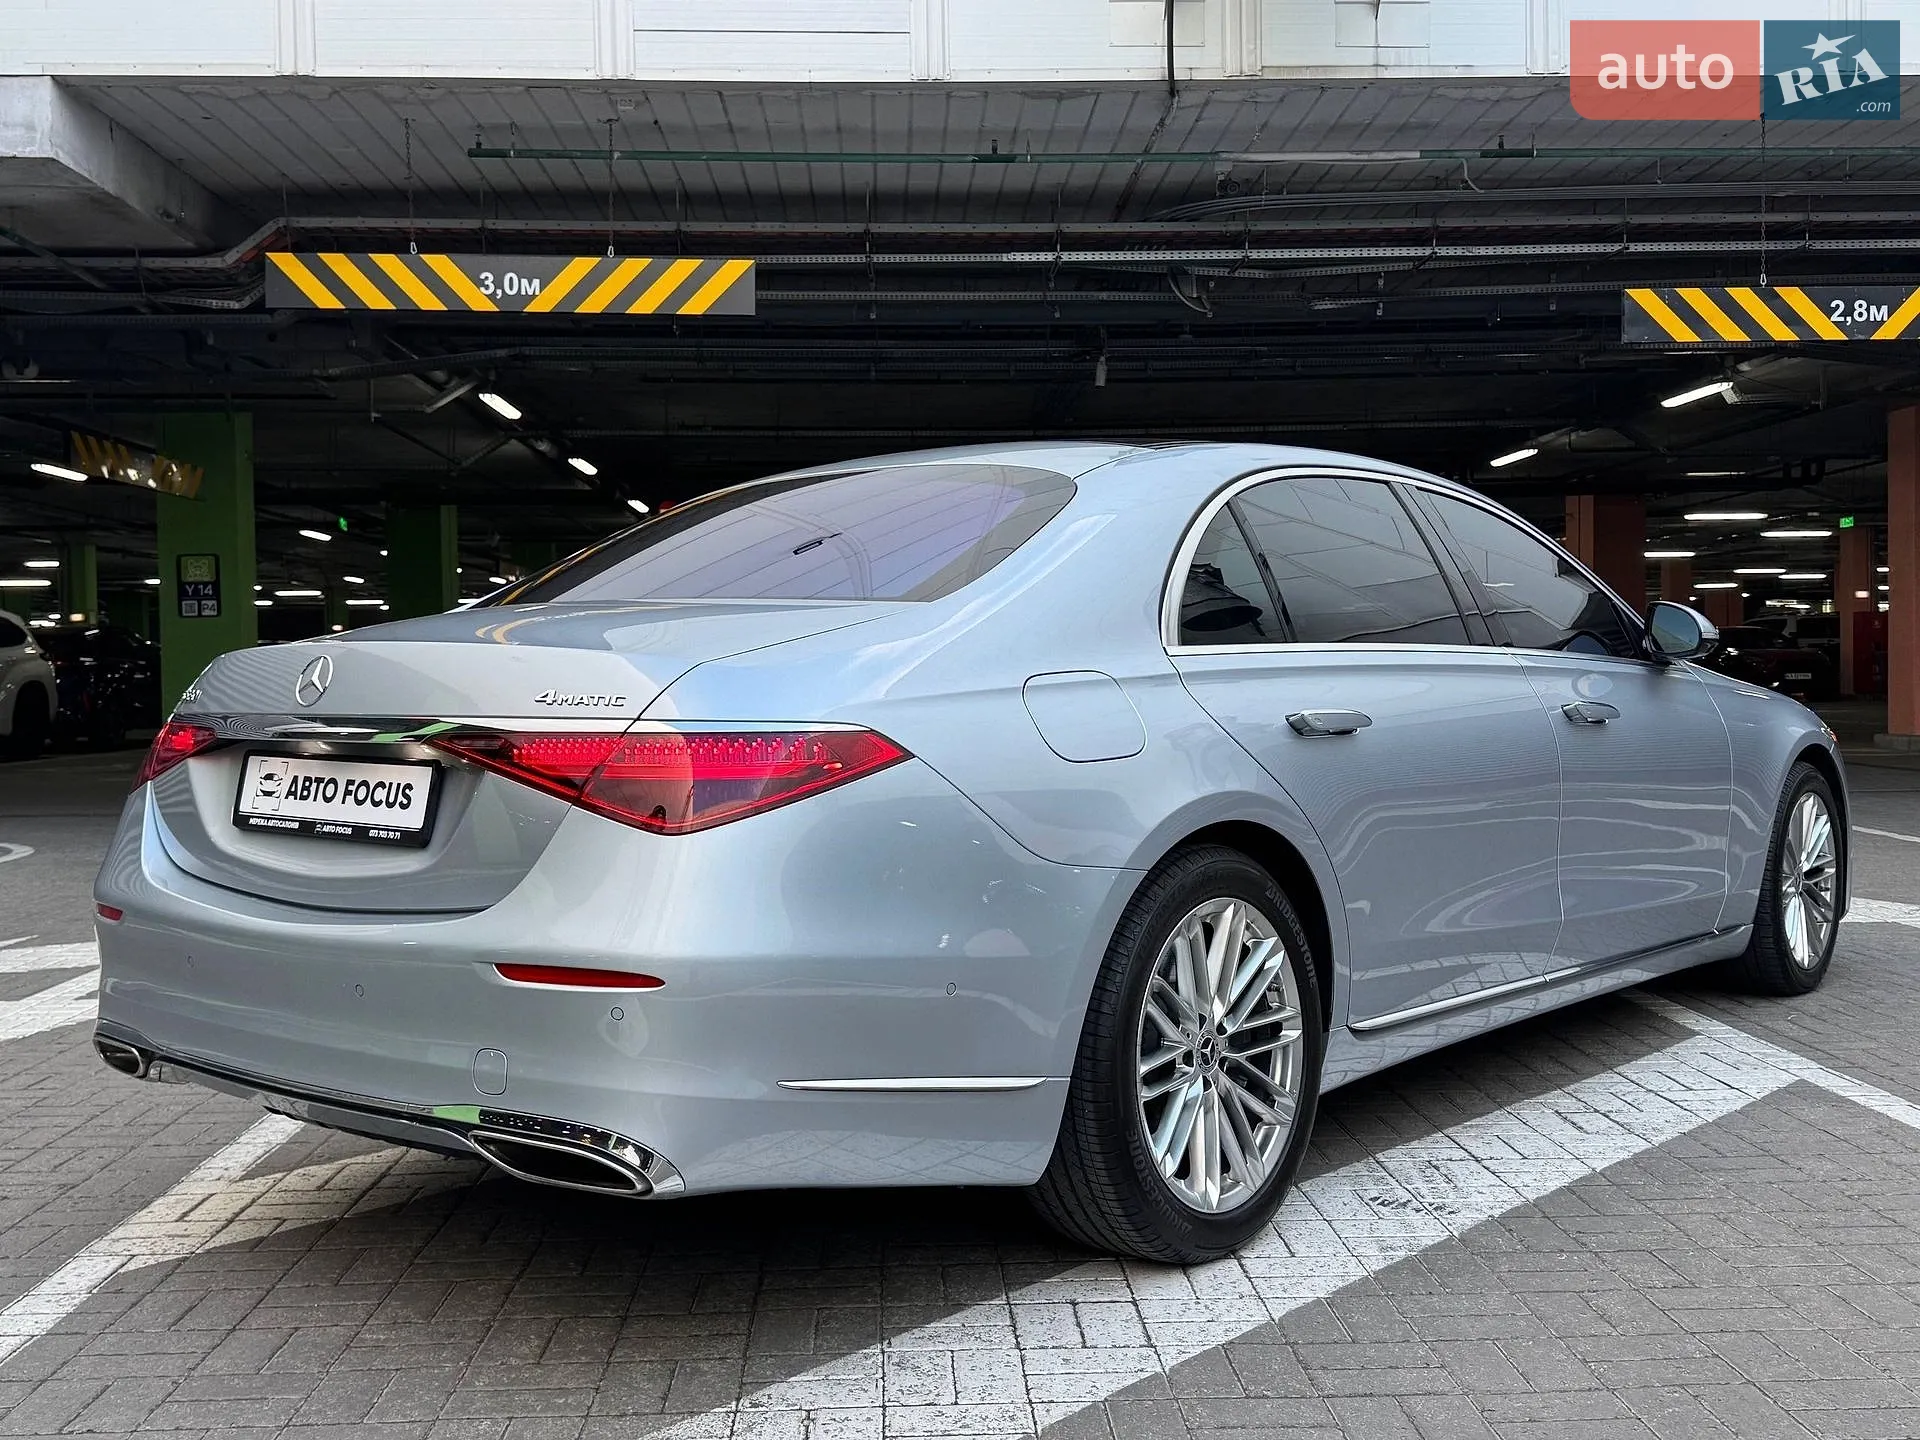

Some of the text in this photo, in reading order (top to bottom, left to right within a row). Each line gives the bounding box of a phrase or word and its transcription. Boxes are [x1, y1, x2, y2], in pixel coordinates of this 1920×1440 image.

[479, 271, 541, 299] 3,0м
[1829, 299, 1888, 326] 2,8м
[198, 584, 213, 596] 14
[534, 688, 628, 707] 4MATIC
[341, 778, 414, 811] FOCUS
[335, 826, 353, 835] FOCUS
[1265, 884, 1318, 989] BRIDGESTONE
